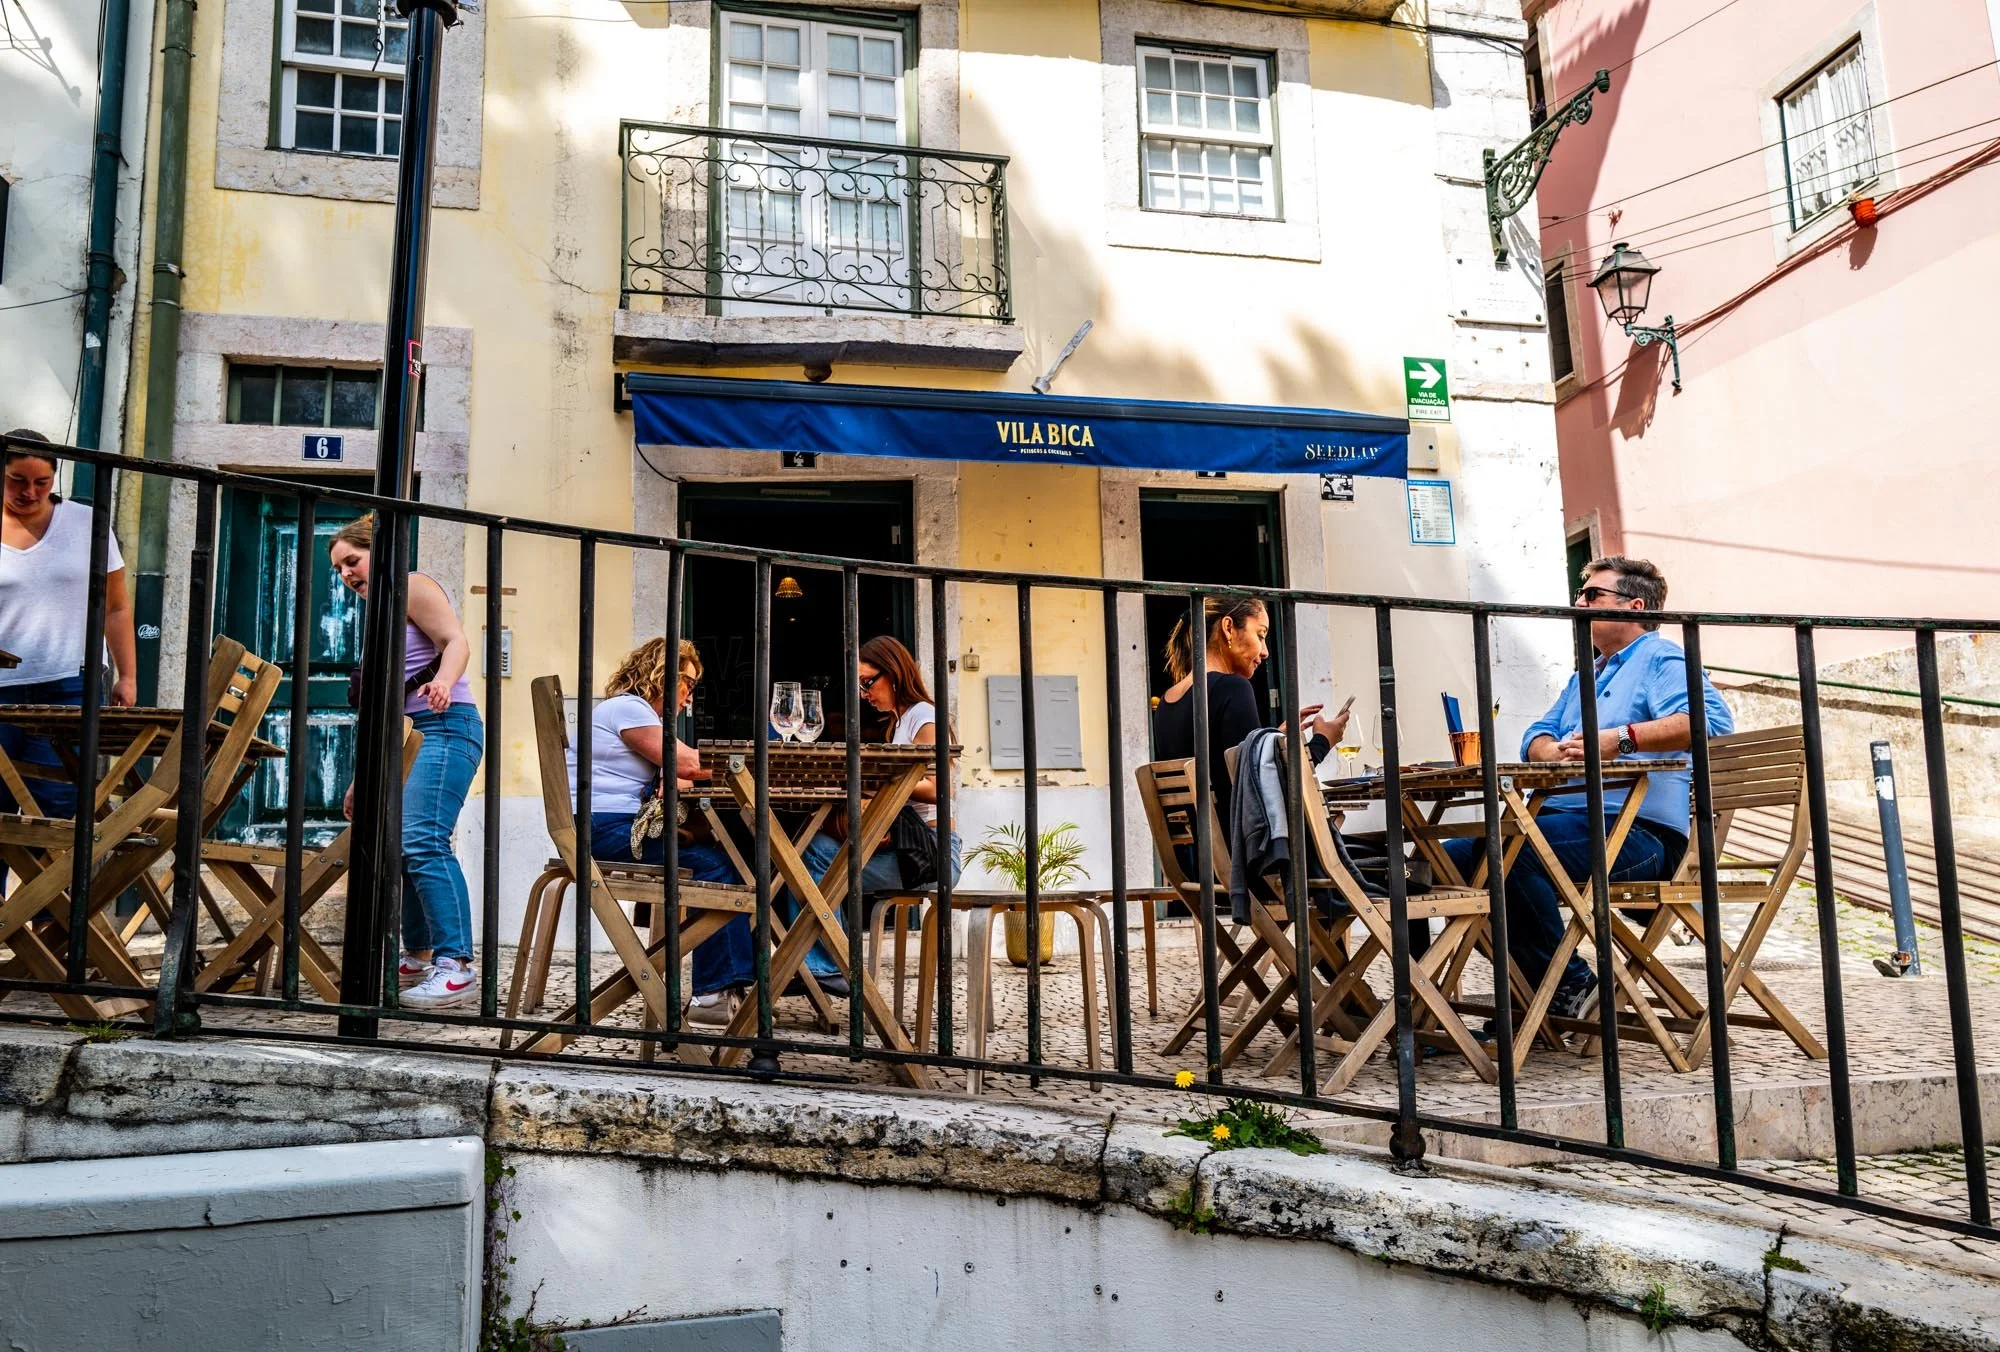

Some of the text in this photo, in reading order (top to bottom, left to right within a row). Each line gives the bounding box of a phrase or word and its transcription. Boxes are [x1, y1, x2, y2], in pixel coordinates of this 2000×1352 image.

[997, 421, 1094, 446] VILA BICA
[316, 437, 329, 459] 6
[1304, 443, 1379, 460] SEEDLIP
